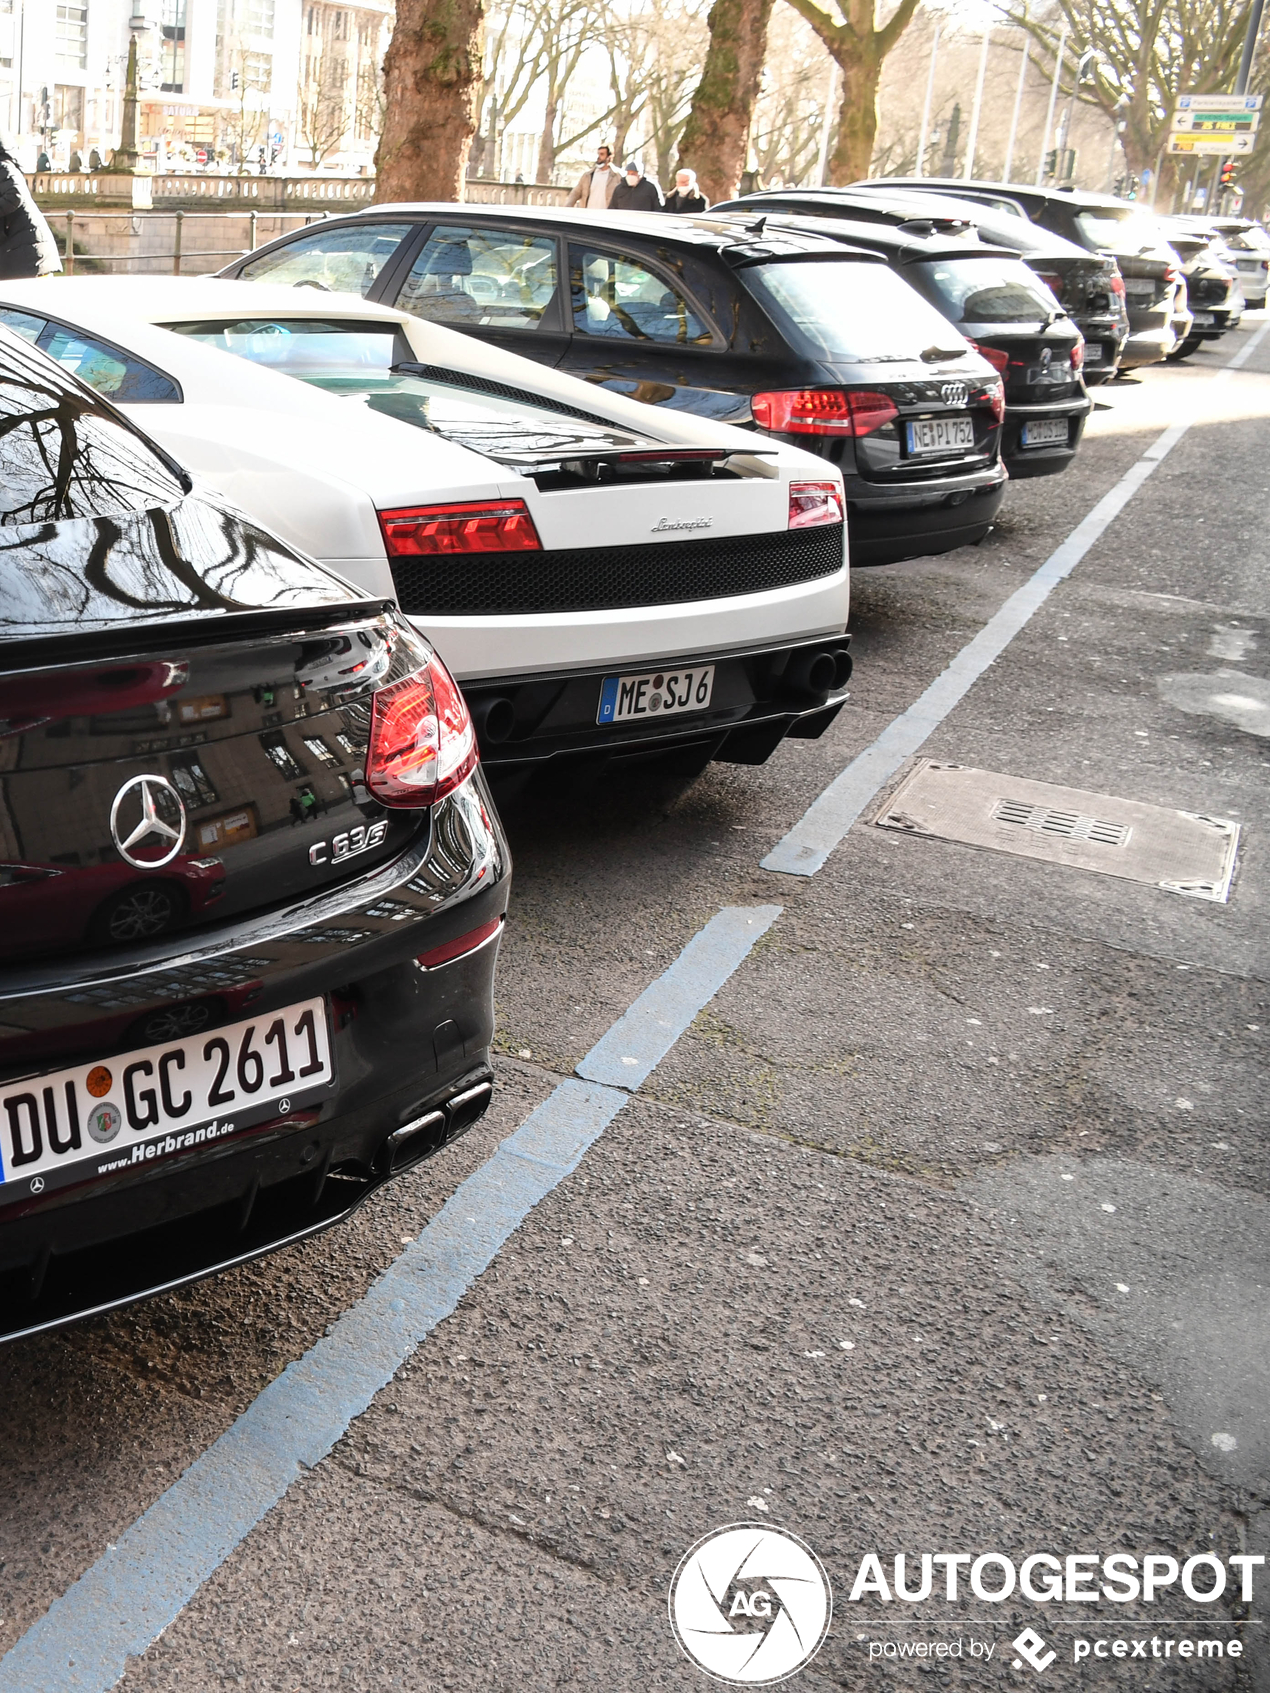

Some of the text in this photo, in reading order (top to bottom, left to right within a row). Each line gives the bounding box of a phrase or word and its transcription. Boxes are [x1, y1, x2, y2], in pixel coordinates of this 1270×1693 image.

[914, 421, 972, 448] NE PI 752
[650, 515, 714, 533] Lamborghini
[618, 679, 651, 716] ME
[3, 1080, 82, 1168] DU
[123, 1048, 192, 1131] GC
[203, 1009, 324, 1107] 2611
[97, 1120, 235, 1174] www.Herbrand.de
